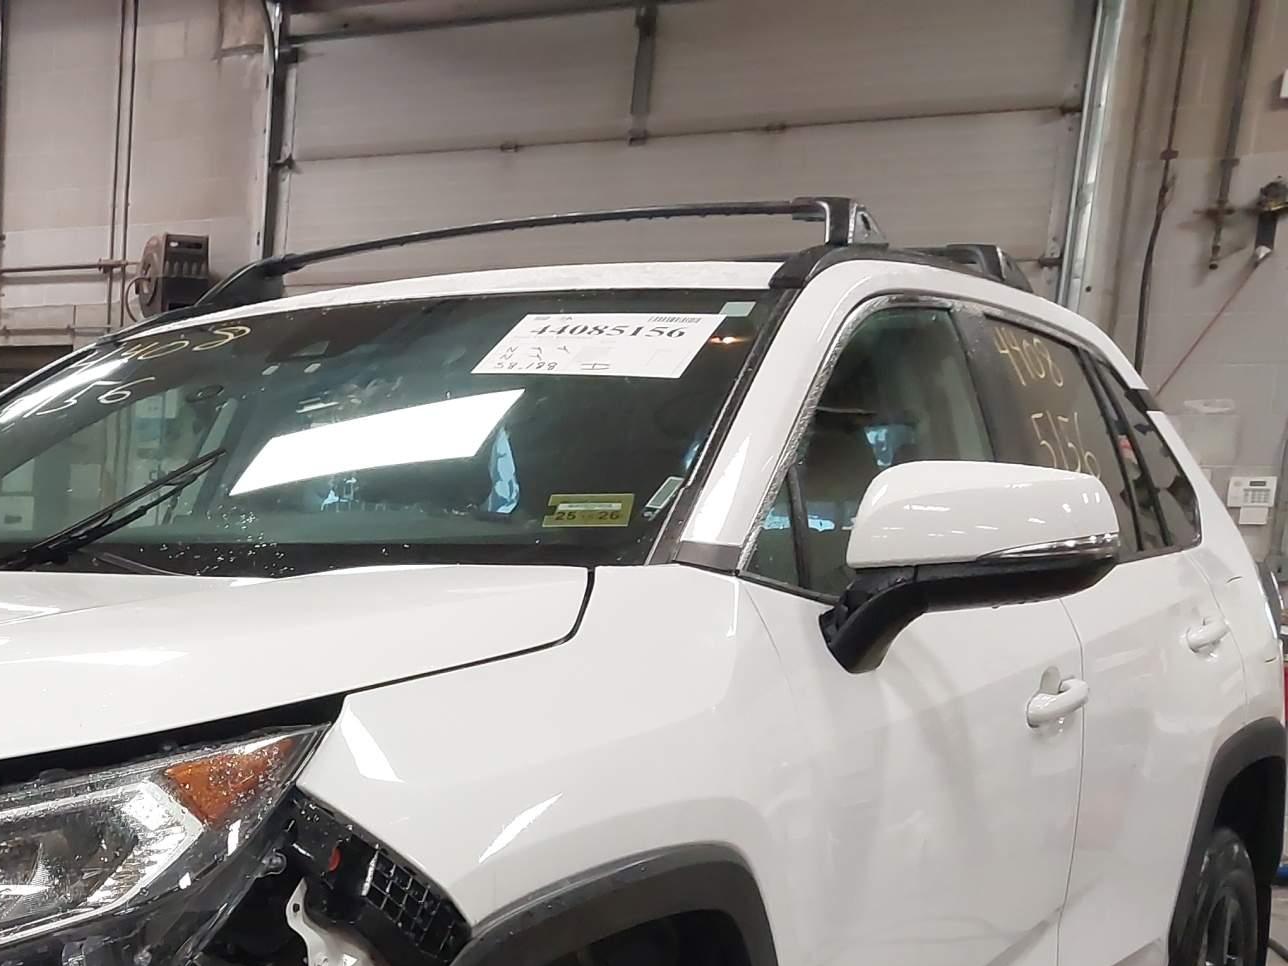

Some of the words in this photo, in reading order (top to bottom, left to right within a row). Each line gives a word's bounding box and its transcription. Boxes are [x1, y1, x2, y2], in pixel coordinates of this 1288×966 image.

[530, 324, 688, 338] 44085156
[994, 327, 1063, 387] 4408
[1031, 411, 1101, 480] 5156
[554, 511, 577, 521] 25
[598, 511, 620, 521] 26
